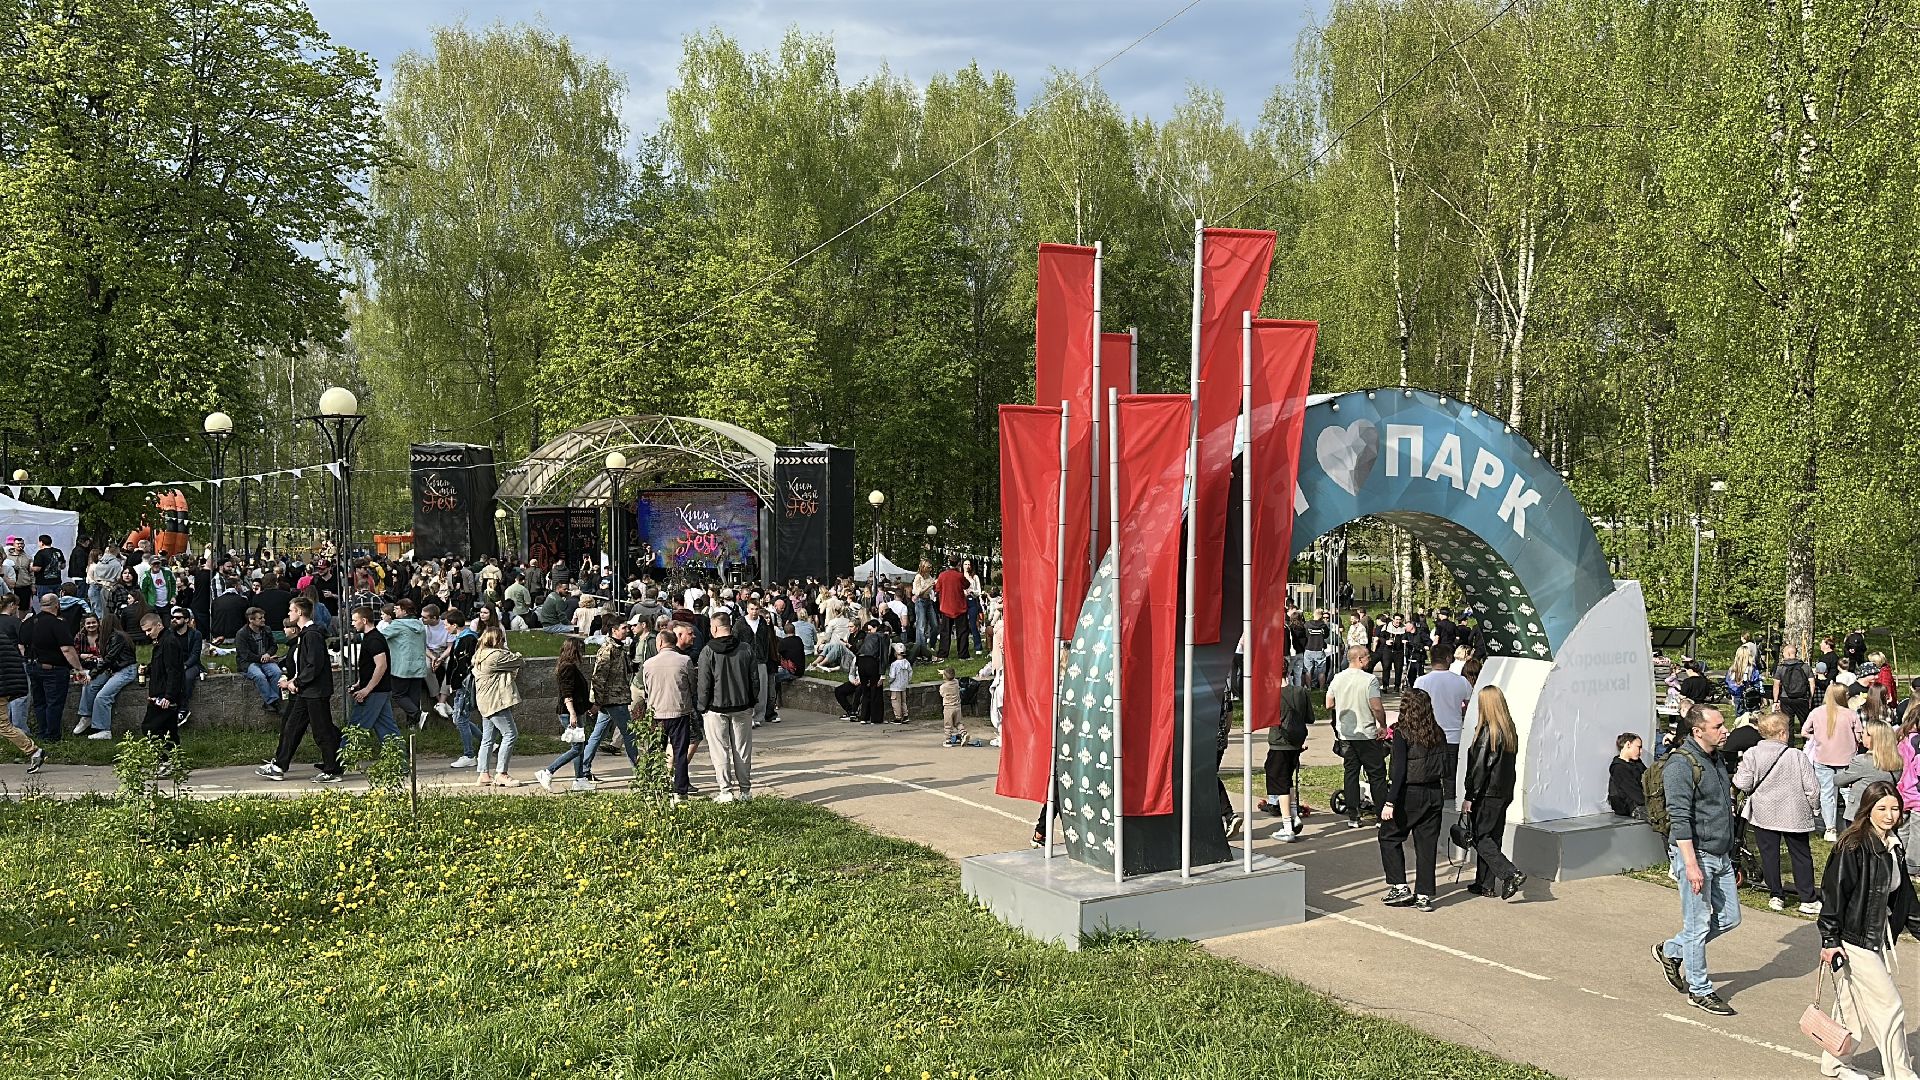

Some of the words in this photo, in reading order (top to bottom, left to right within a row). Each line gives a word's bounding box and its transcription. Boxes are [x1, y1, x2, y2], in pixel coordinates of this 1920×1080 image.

[1386, 424, 1542, 538] ПАРК
[422, 490, 457, 513] Fest
[785, 495, 819, 518] Fest
[676, 526, 720, 555] Fest
[1563, 650, 1637, 669] Хорошего
[1571, 673, 1631, 696] отдыха!
